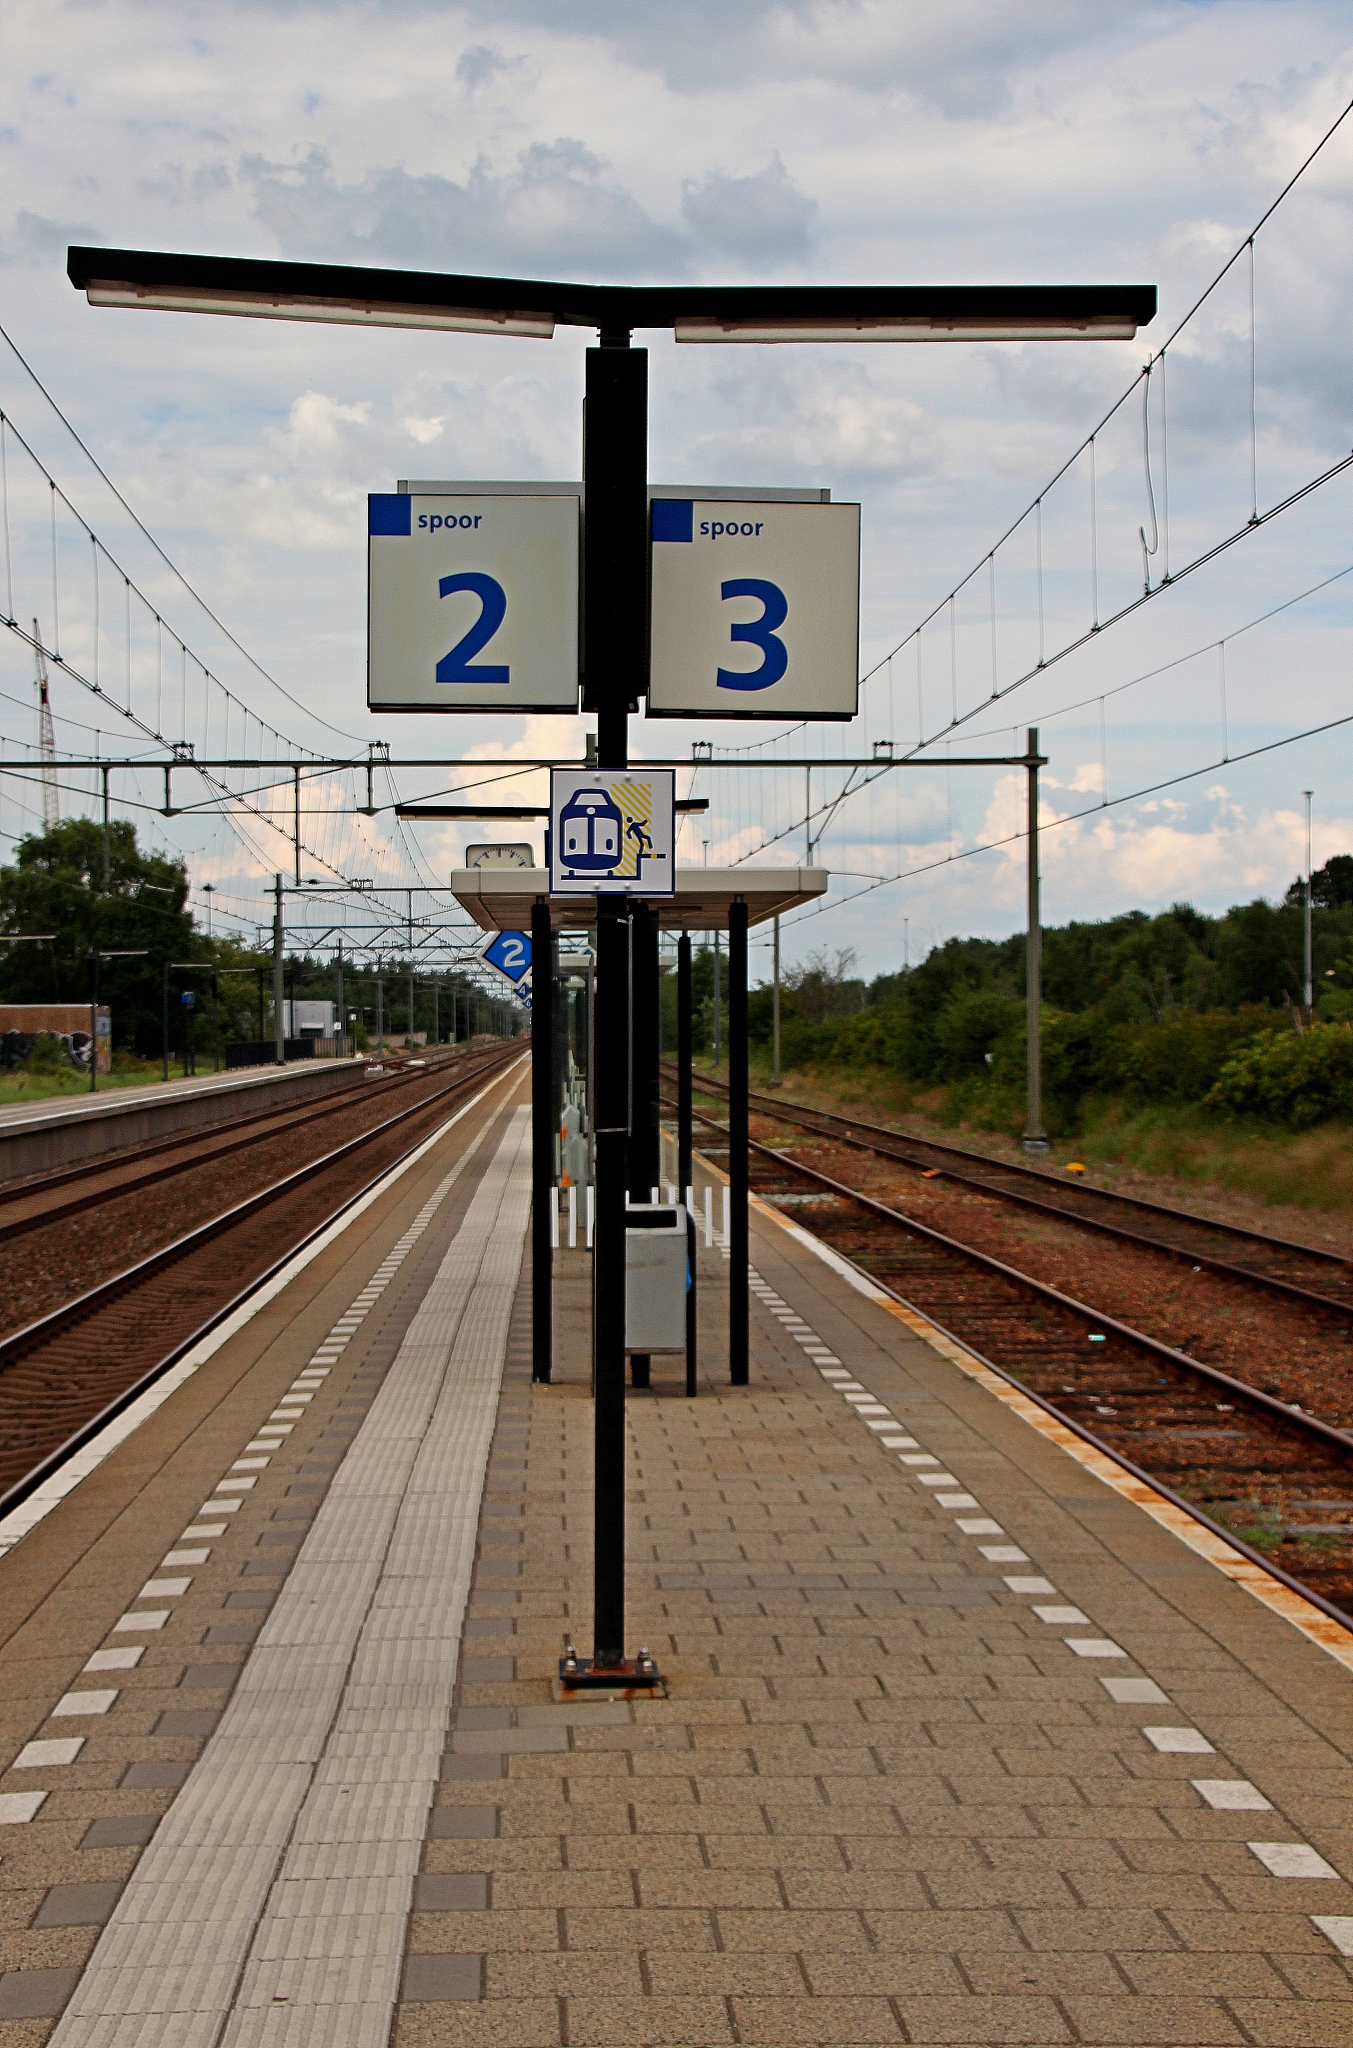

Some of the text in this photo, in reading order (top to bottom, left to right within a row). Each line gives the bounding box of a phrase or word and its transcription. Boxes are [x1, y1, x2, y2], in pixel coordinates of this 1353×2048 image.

[418, 512, 482, 533] spoor
[700, 519, 764, 540] spoor
[435, 572, 510, 684] 2
[716, 578, 789, 692] 3
[501, 938, 526, 968] 2
